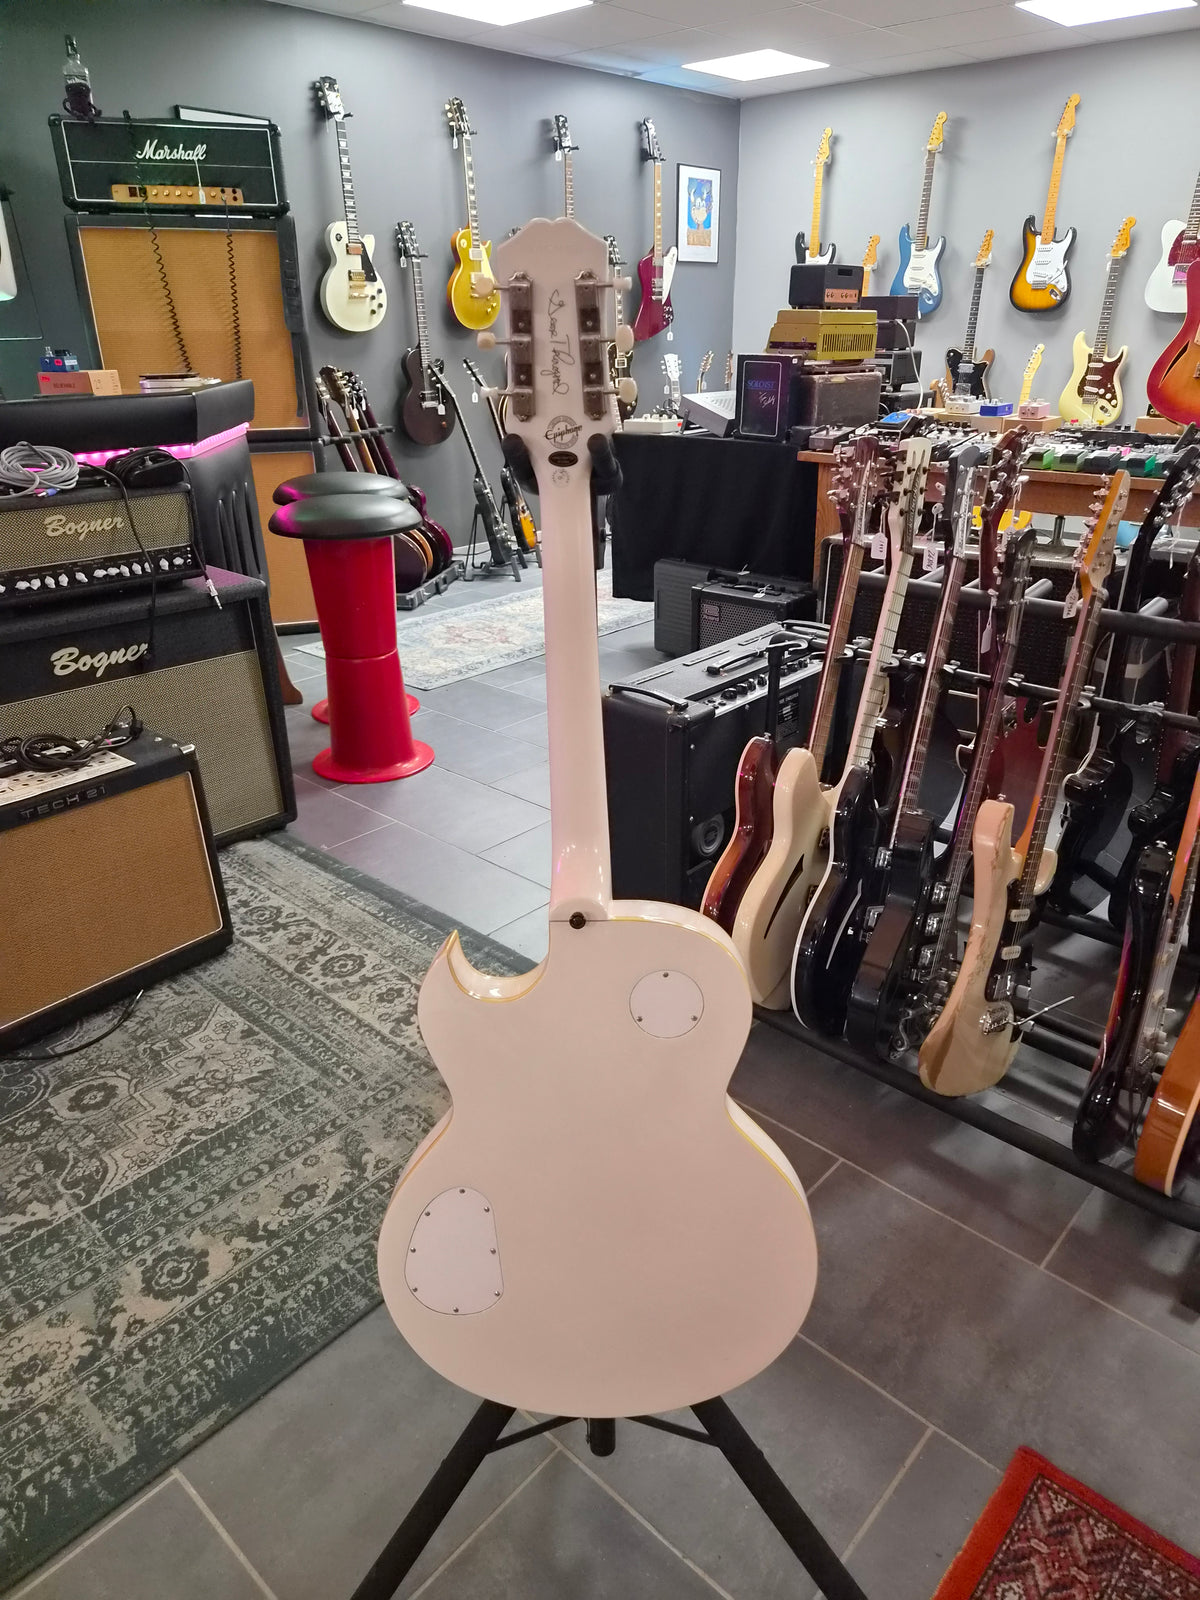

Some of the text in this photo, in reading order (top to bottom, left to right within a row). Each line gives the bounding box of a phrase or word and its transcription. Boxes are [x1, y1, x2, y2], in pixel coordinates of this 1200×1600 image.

[136, 139, 207, 160] Marshall
[543, 424, 582, 443] Epiphone
[44, 514, 125, 541] Bogner
[20, 786, 106, 818] TECH 21
